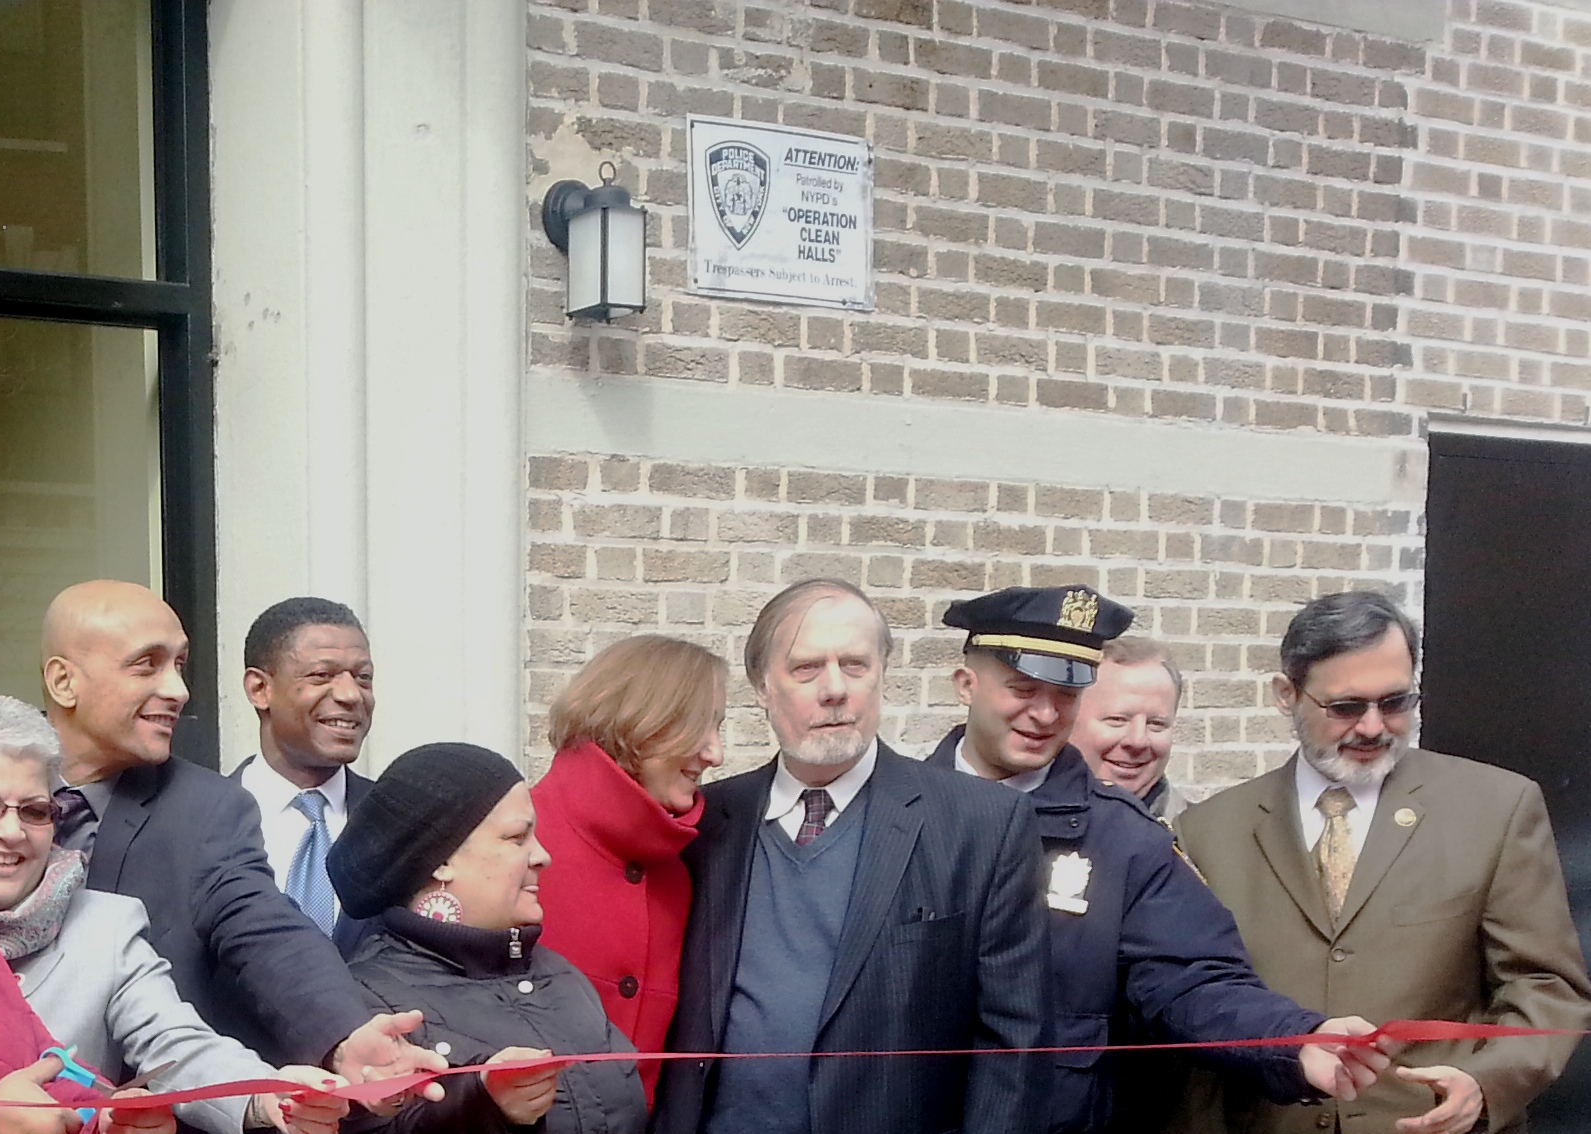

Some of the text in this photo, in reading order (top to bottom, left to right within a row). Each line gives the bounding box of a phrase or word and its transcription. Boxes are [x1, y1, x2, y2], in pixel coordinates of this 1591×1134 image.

[722, 148, 755, 163] POLICE
[784, 147, 859, 171] ATTENTION:
[712, 160, 765, 181] DEPARTMENT
[796, 173, 843, 193] Patrolled by
[800, 227, 840, 245] CLEAN
[704, 259, 765, 279] Trespassers
[769, 269, 806, 284] Subject
[810, 273, 819, 284] to
